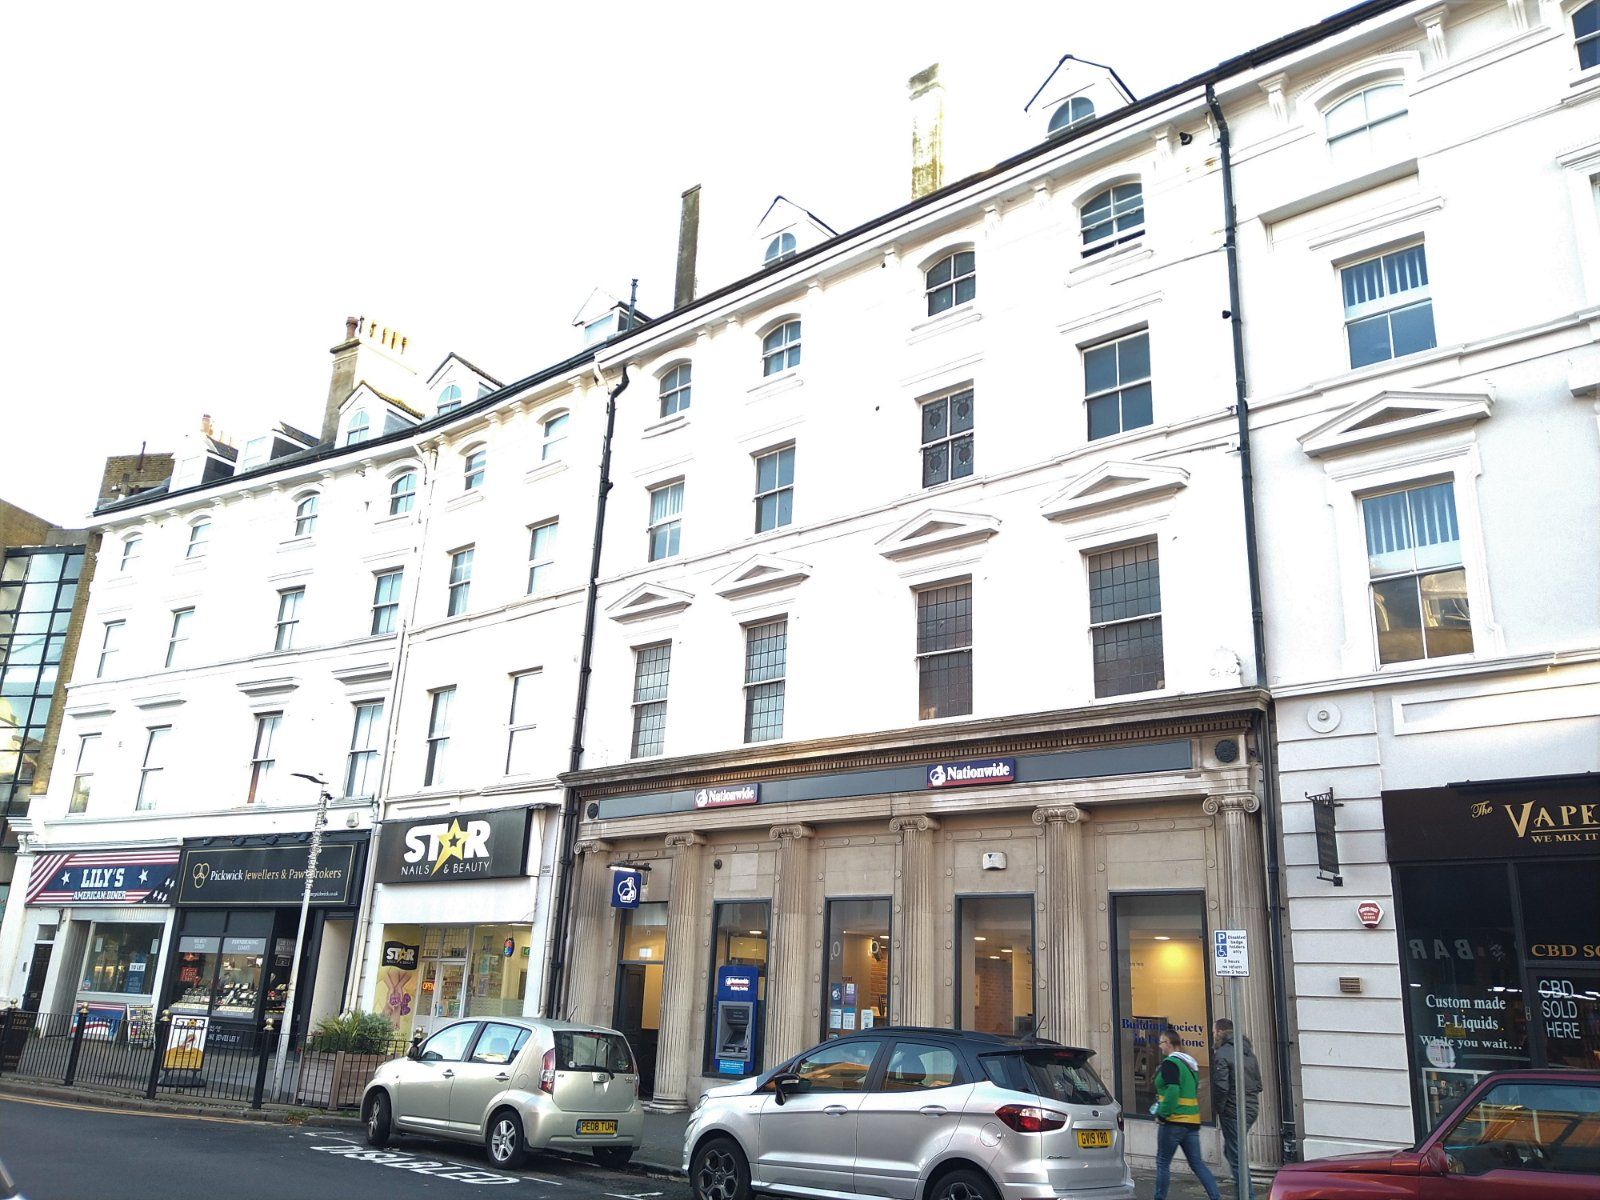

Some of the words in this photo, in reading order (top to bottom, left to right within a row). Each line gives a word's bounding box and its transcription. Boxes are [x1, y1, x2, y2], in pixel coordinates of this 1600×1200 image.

[946, 763, 1010, 780] Nationwide
[708, 787, 755, 803] Nationwide
[1470, 800, 1494, 819] The
[1500, 800, 1600, 838] VAPE
[1531, 835, 1552, 843] WE
[1555, 834, 1581, 842] MIX
[1585, 833, 1599, 841] IT
[210, 869, 243, 881] Pickwick
[244, 869, 279, 883] Jewellers
[280, 870, 288, 880] &
[401, 864, 430, 876] NAILS
[443, 864, 450, 874] &
[452, 861, 490, 874] BEAUTY
[80, 868, 126, 888] LILY'S
[72, 891, 105, 900] AMERICAN
[106, 891, 127, 900] DINER
[1531, 944, 1577, 957] CBD
[1539, 980, 1574, 999] CBD
[1425, 994, 1471, 1009] Custom
[1474, 996, 1506, 1010] made
[1542, 1000, 1578, 1019] SOLD
[1454, 1015, 1499, 1033] Liquids
[1546, 1021, 1582, 1039] HERE
[1418, 1035, 1454, 1046] While
[1457, 1038, 1479, 1049] you
[309, 1145, 520, 1185] DISABLED
